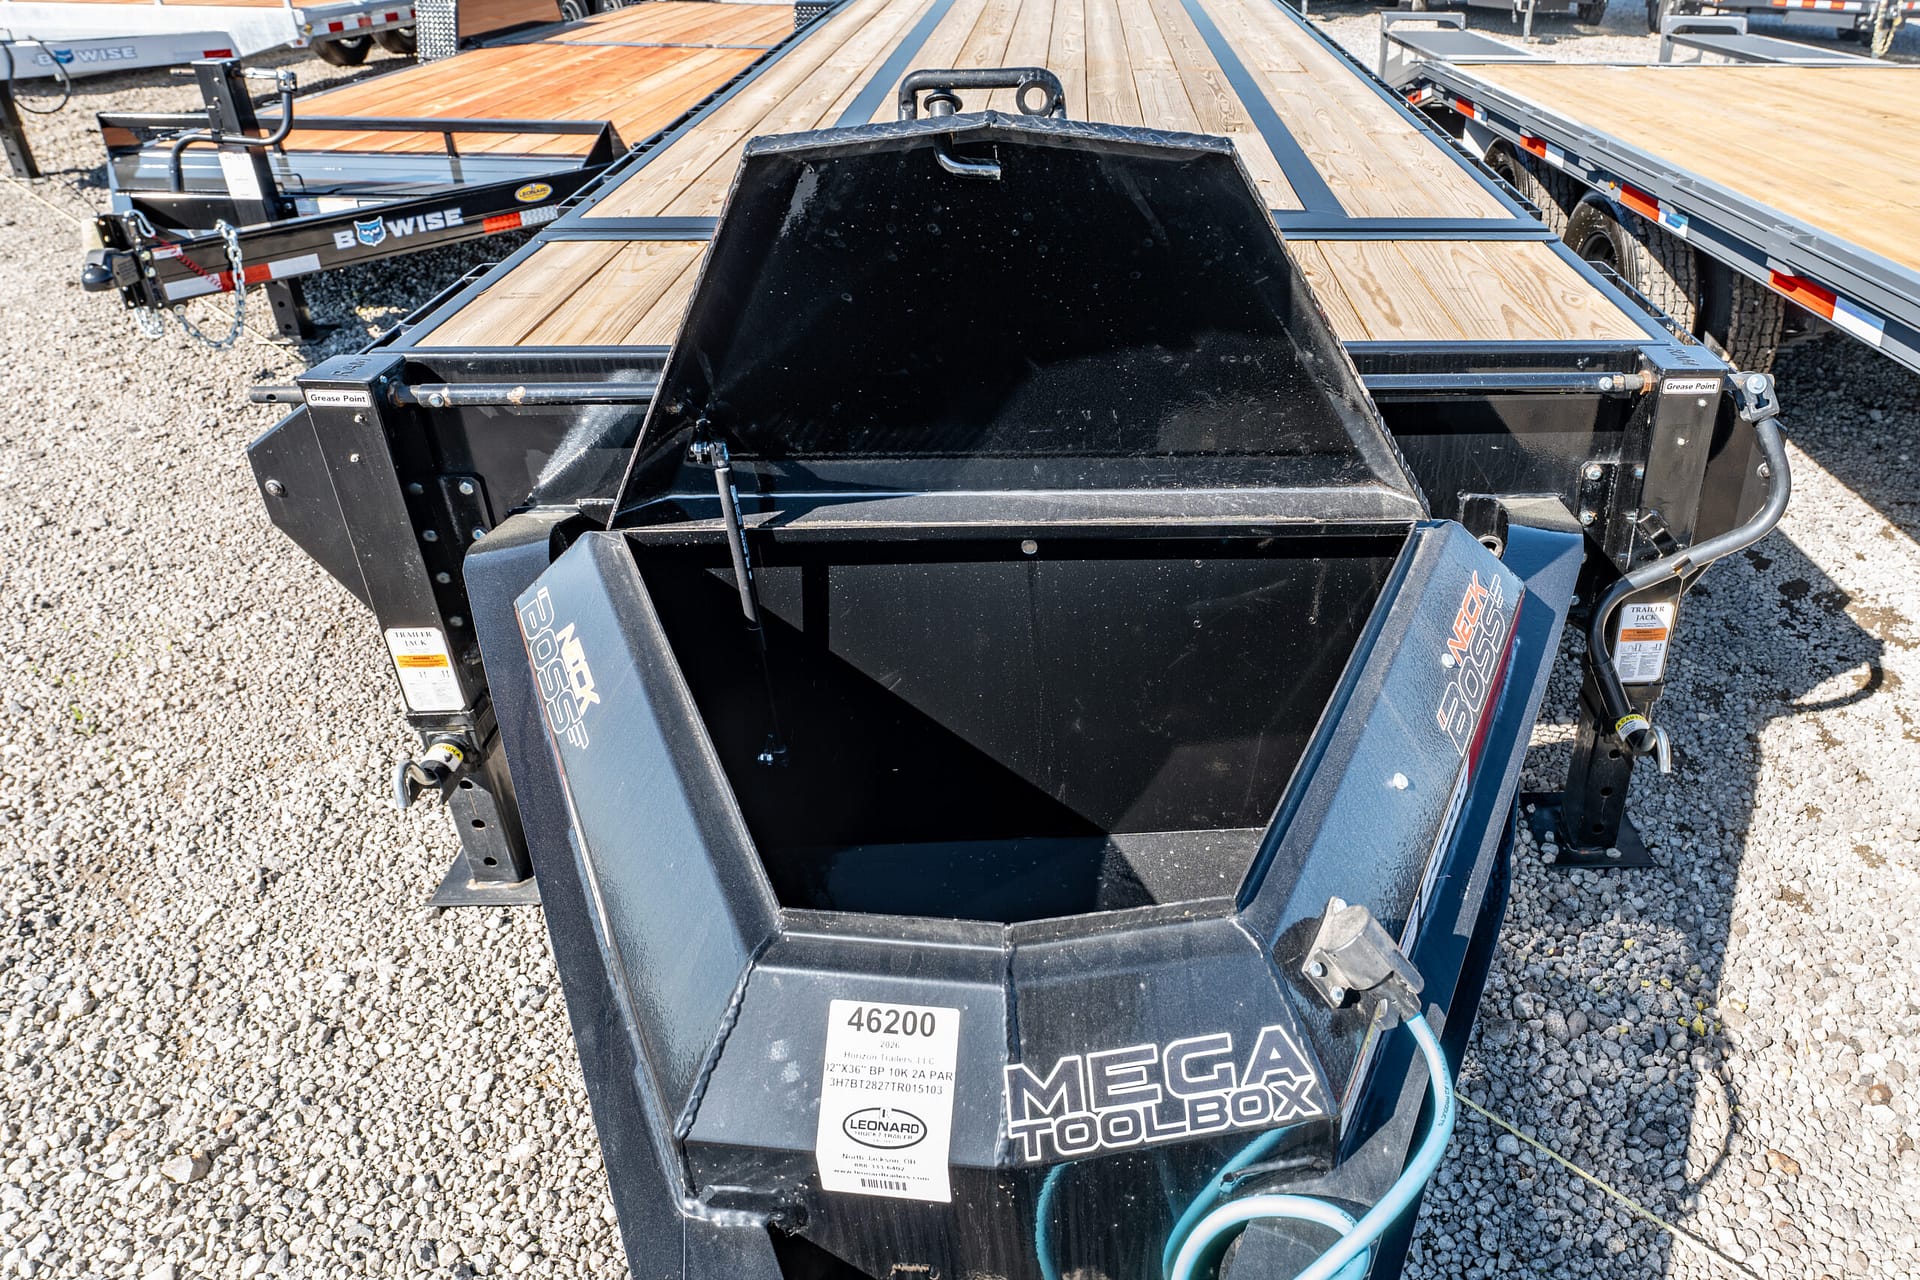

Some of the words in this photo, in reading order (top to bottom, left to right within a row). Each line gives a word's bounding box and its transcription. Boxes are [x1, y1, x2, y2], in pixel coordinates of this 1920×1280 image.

[76, 45, 138, 63] WISE
[386, 207, 464, 238] WISE
[1666, 382, 1693, 390] Grease
[1695, 382, 1716, 390] Point
[310, 393, 340, 402] Grease
[343, 394, 366, 403] Point
[1447, 570, 1488, 666] NECK
[1631, 605, 1665, 613] TRAILER
[1635, 614, 1657, 622] JACK
[520, 587, 582, 735] BOSS
[1437, 590, 1506, 757] BOSS
[847, 1006, 936, 1037] 46200
[869, 1065, 884, 1076] BP
[890, 1067, 908, 1078] 10K
[912, 1069, 926, 1079] 2A
[929, 1070, 953, 1081] PAR
[1004, 1025, 1317, 1125] MEGA
[829, 1077, 943, 1095] 3H7BT2827TR015103
[850, 1119, 920, 1134] LEONARD
[1008, 1074, 1324, 1162] TOOLBOX
